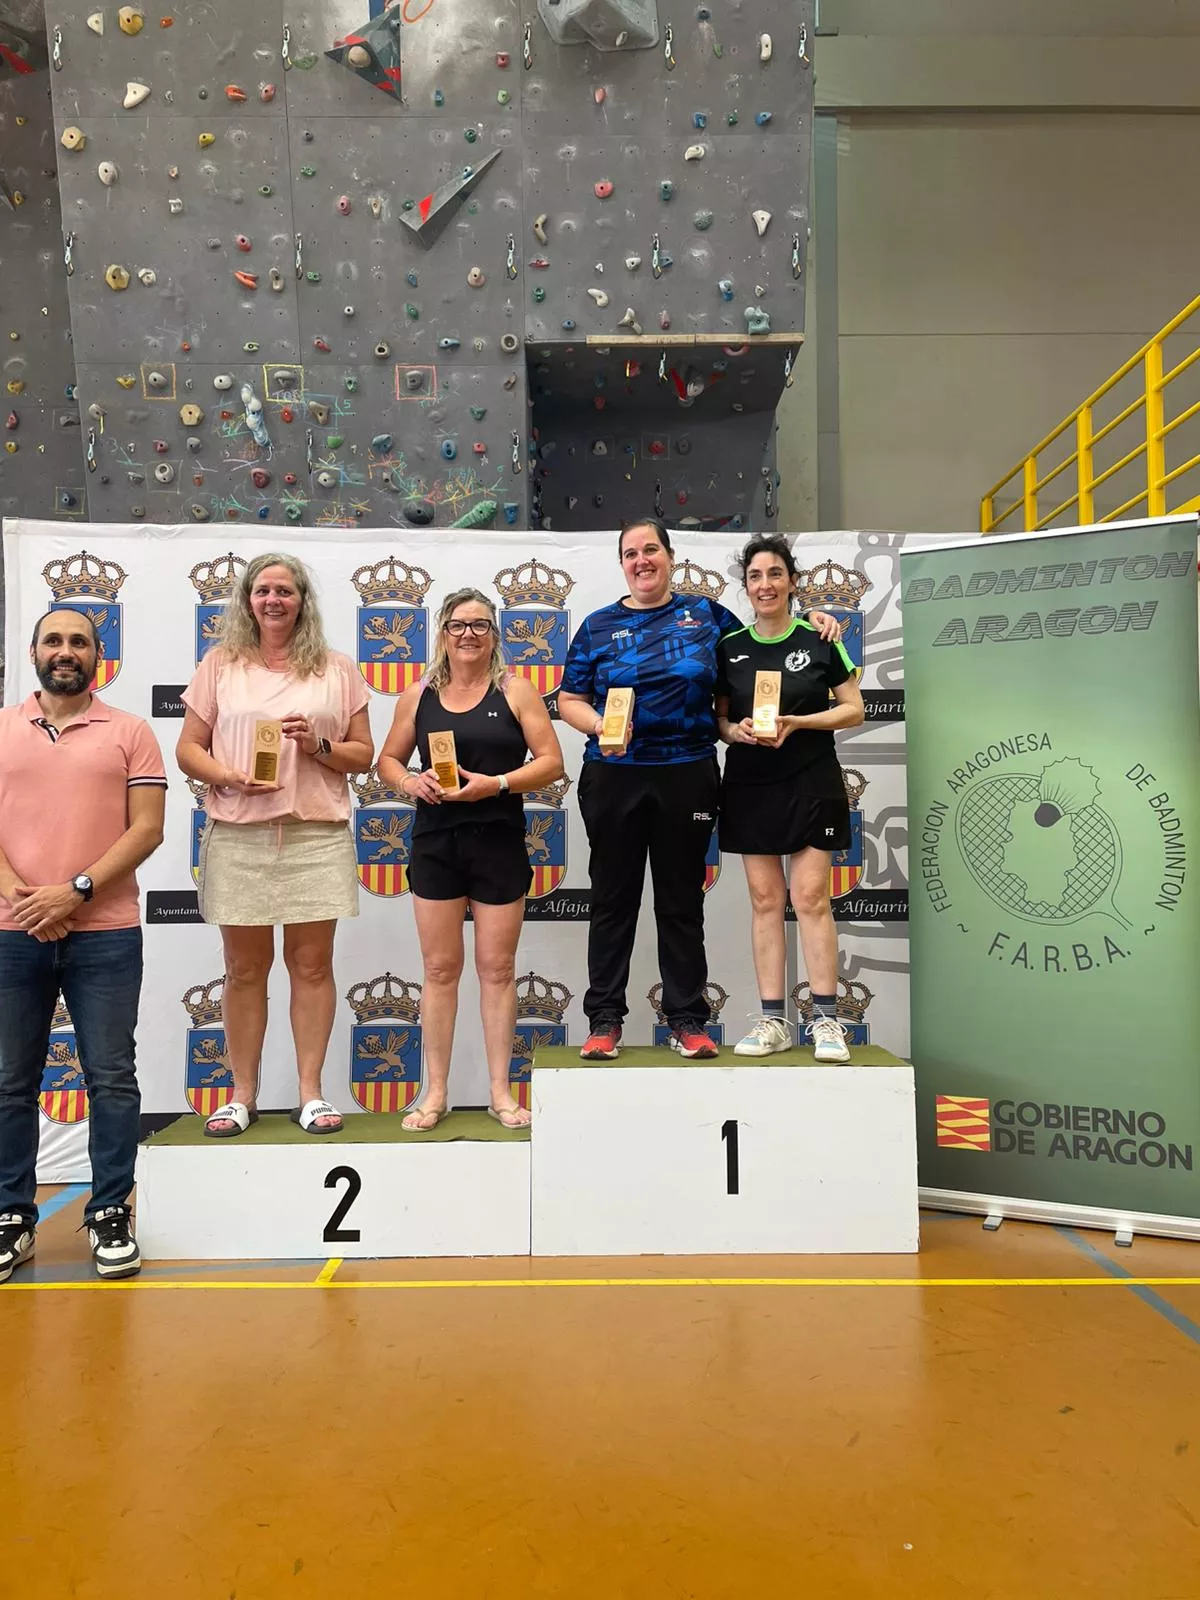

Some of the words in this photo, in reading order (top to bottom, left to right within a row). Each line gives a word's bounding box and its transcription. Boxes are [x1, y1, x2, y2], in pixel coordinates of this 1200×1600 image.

[904, 551, 1194, 604] BADMINTON
[612, 629, 633, 640] RSL
[932, 600, 1159, 647] ARAGON
[693, 812, 712, 821] RSL
[921, 800, 952, 913] FEDERACION
[946, 732, 1052, 794] ARAGONESA
[1125, 763, 1157, 791] DE
[1148, 792, 1186, 911] BADMINTON
[993, 1099, 1167, 1138] GOBIERNO
[721, 1119, 739, 1195] 1
[994, 1128, 1036, 1156] DE
[1047, 1133, 1193, 1171] ARAGON
[323, 1165, 362, 1242] 2
